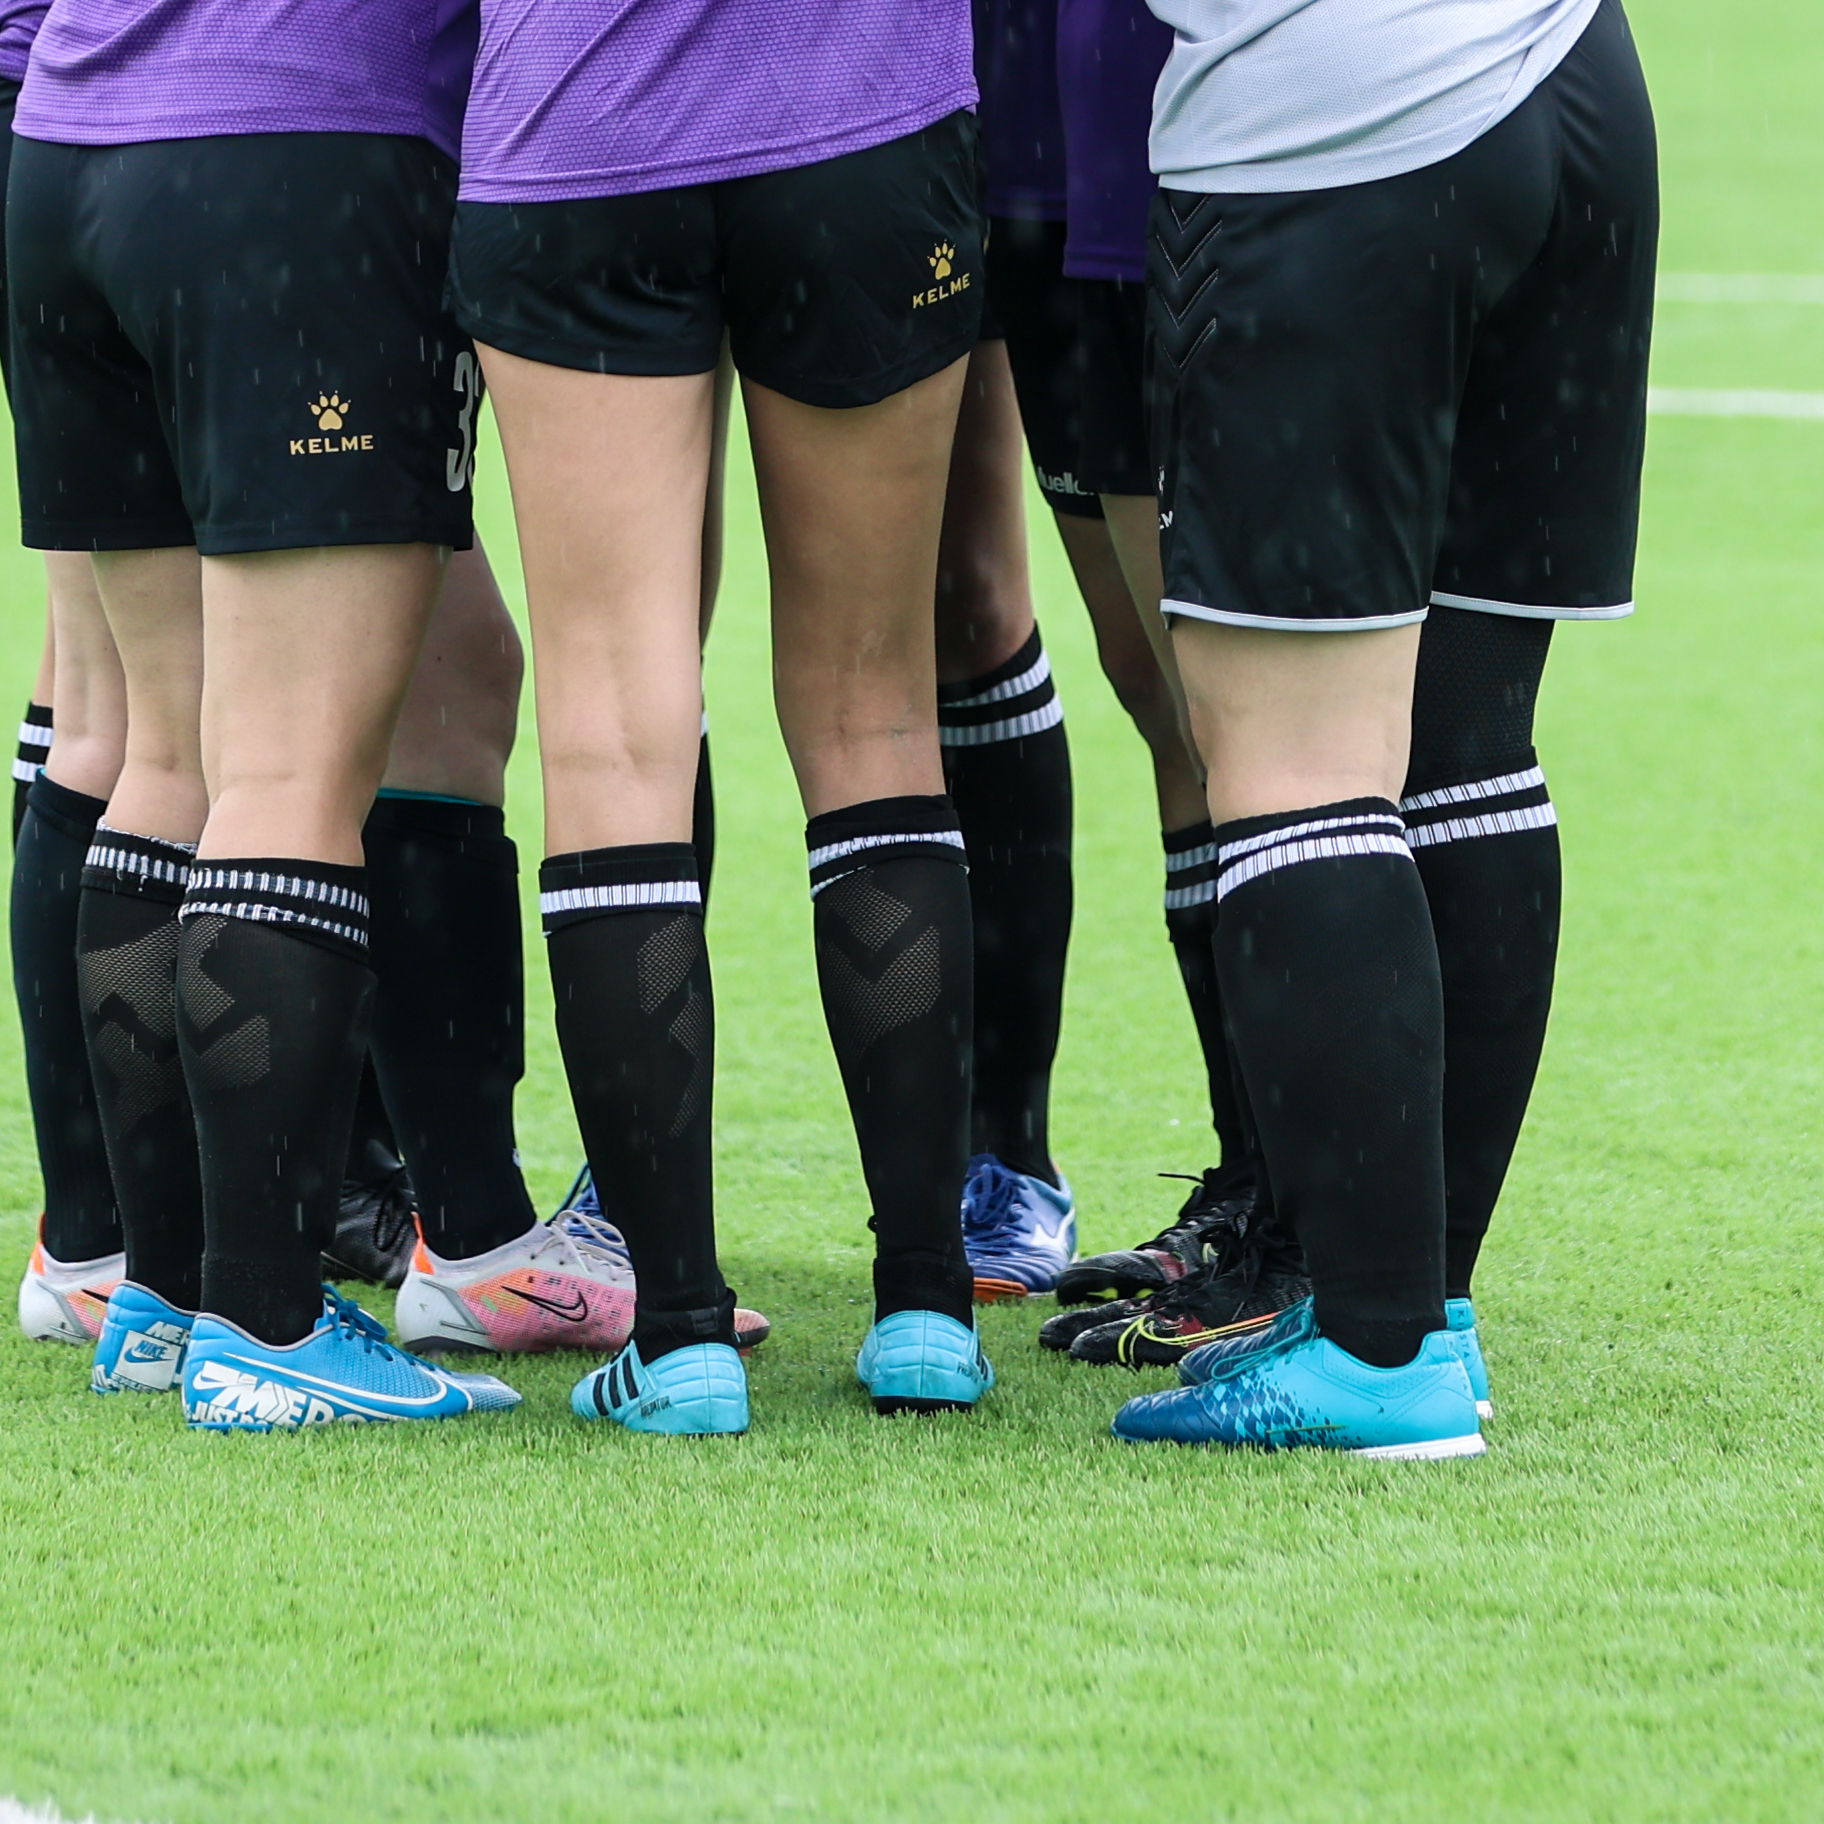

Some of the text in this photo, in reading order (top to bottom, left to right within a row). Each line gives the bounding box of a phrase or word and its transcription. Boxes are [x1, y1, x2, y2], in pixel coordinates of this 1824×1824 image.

[912, 272, 971, 309] KELME
[446, 351, 481, 492] 3
[290, 435, 375, 455] KELME
[136, 1339, 168, 1359] NIKE
[201, 1360, 368, 1426] MER
